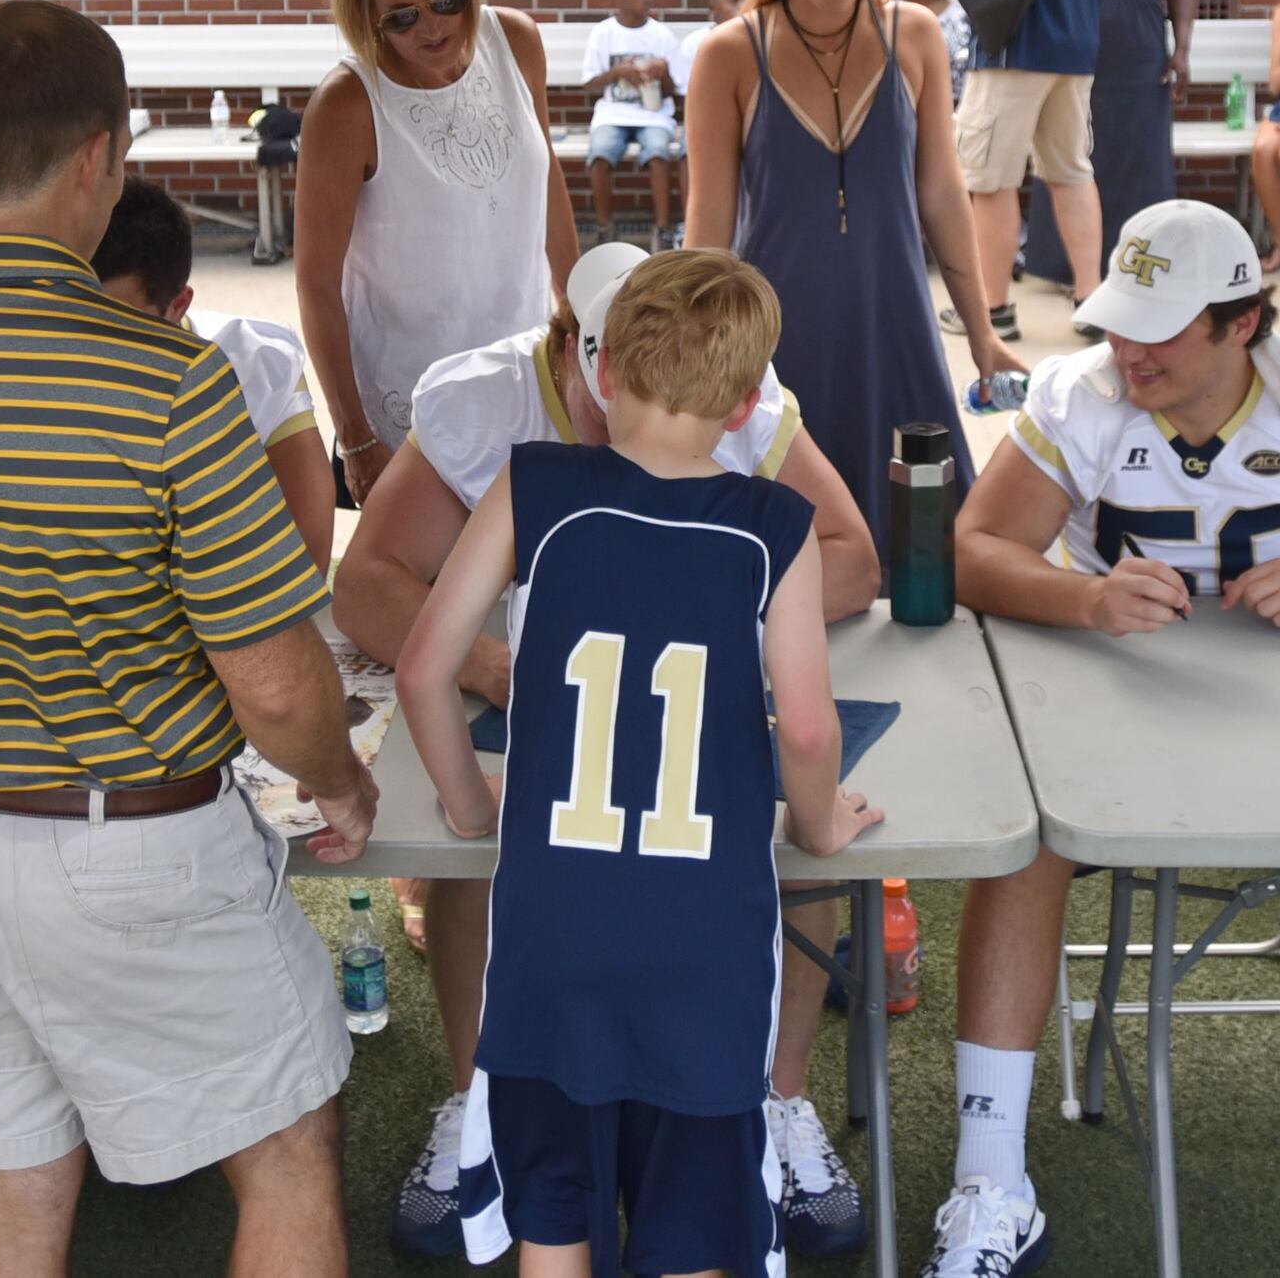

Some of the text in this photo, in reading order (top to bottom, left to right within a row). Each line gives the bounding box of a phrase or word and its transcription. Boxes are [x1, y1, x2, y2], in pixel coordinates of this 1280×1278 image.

[1117, 236, 1171, 287] GT
[1184, 457, 1209, 473] GT
[548, 630, 713, 861] 11
